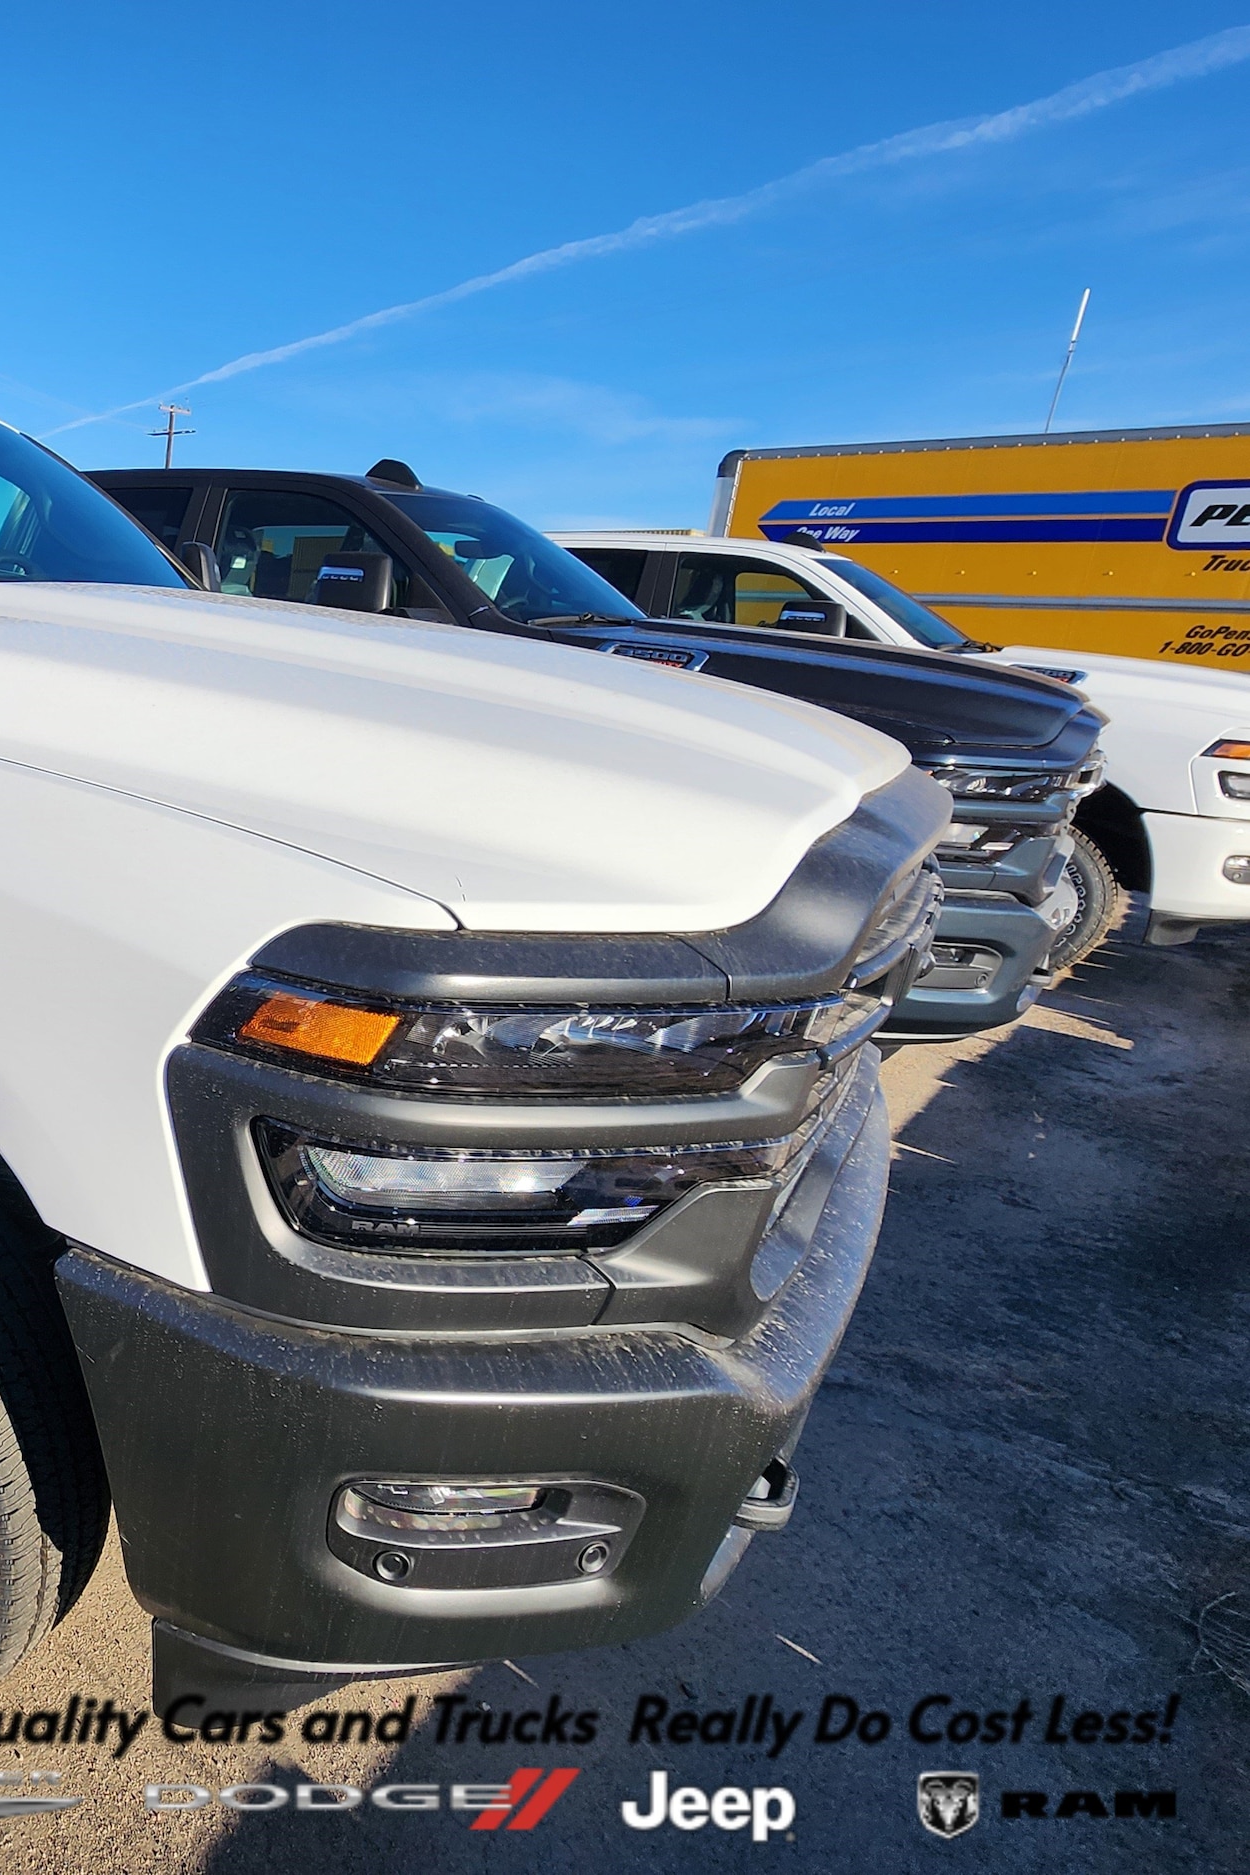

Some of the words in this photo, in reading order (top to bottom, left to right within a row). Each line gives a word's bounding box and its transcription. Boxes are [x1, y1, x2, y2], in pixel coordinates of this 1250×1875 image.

[808, 502, 856, 517] Local
[823, 526, 861, 542] Way
[1185, 625, 1250, 640] GoPen
[1159, 641, 1250, 657] 1-800-GO
[352, 1220, 419, 1235] RAM
